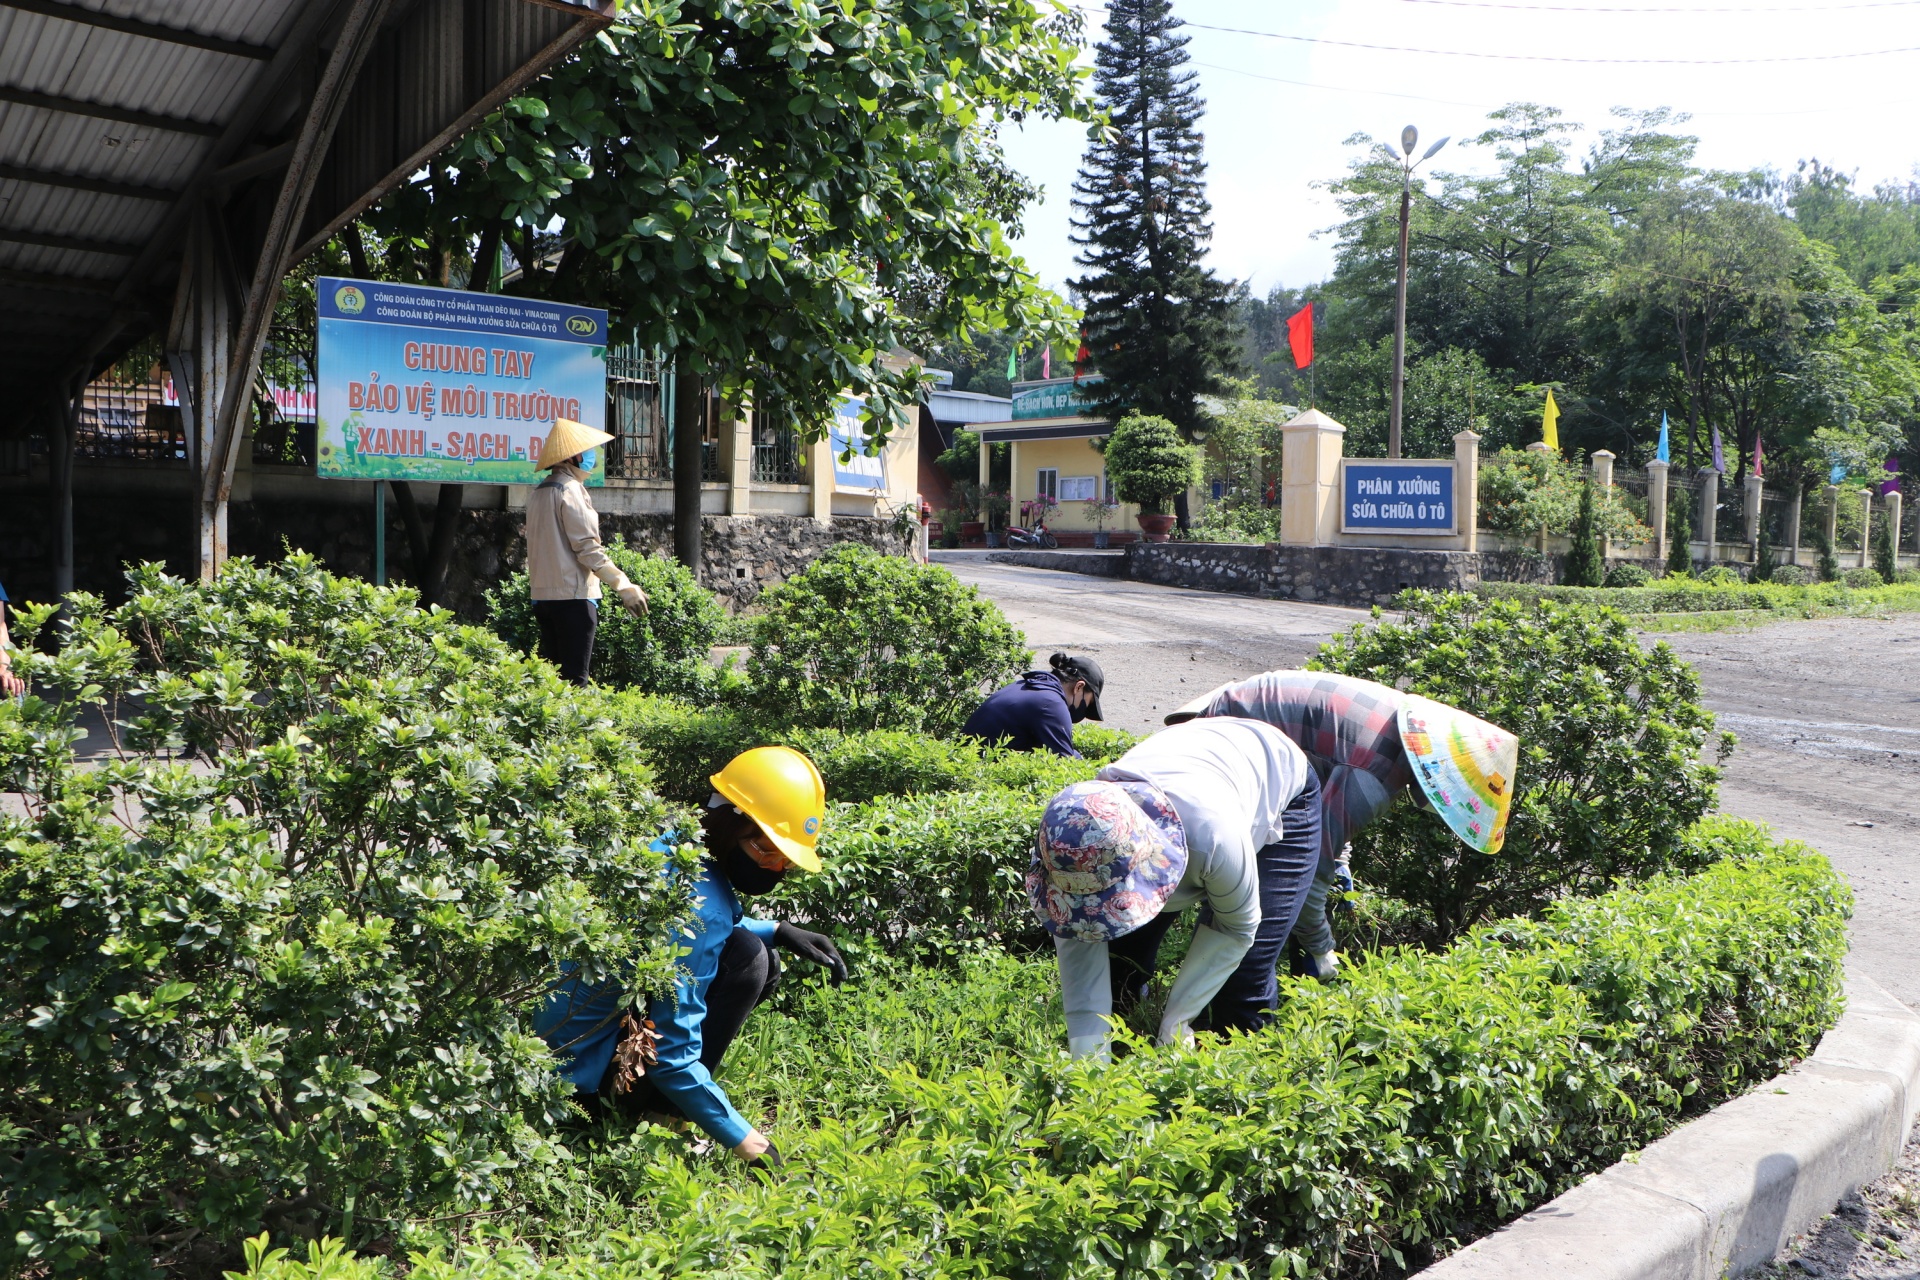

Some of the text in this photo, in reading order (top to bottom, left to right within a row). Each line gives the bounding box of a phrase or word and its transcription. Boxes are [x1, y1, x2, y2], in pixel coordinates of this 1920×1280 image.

[373, 291, 394, 303] CÔNG
[395, 294, 415, 305] ĐOÀN
[416, 296, 435, 307] CÔNG
[436, 300, 446, 308] TY
[446, 297, 456, 309] CỔ
[476, 303, 494, 313] THAN
[509, 307, 521, 316] NAI
[525, 309, 560, 321] VINACOMIN
[376, 305, 558, 333] CÔNG ĐOÀN BỘ PHẬN PHÂN XƯỞNG SỬA CHỮA Ô TÔ
[404, 341, 534, 379] CHUNG TAY
[348, 370, 581, 423] BẢO VỆ MÔI TRƯỜNG
[357, 426, 425, 457] XANH
[446, 431, 509, 465] SẠCH
[1357, 475, 1440, 495] PHÂN XƯỞNG
[1352, 499, 1445, 520] SỬA CHỮA Ô TÔ
